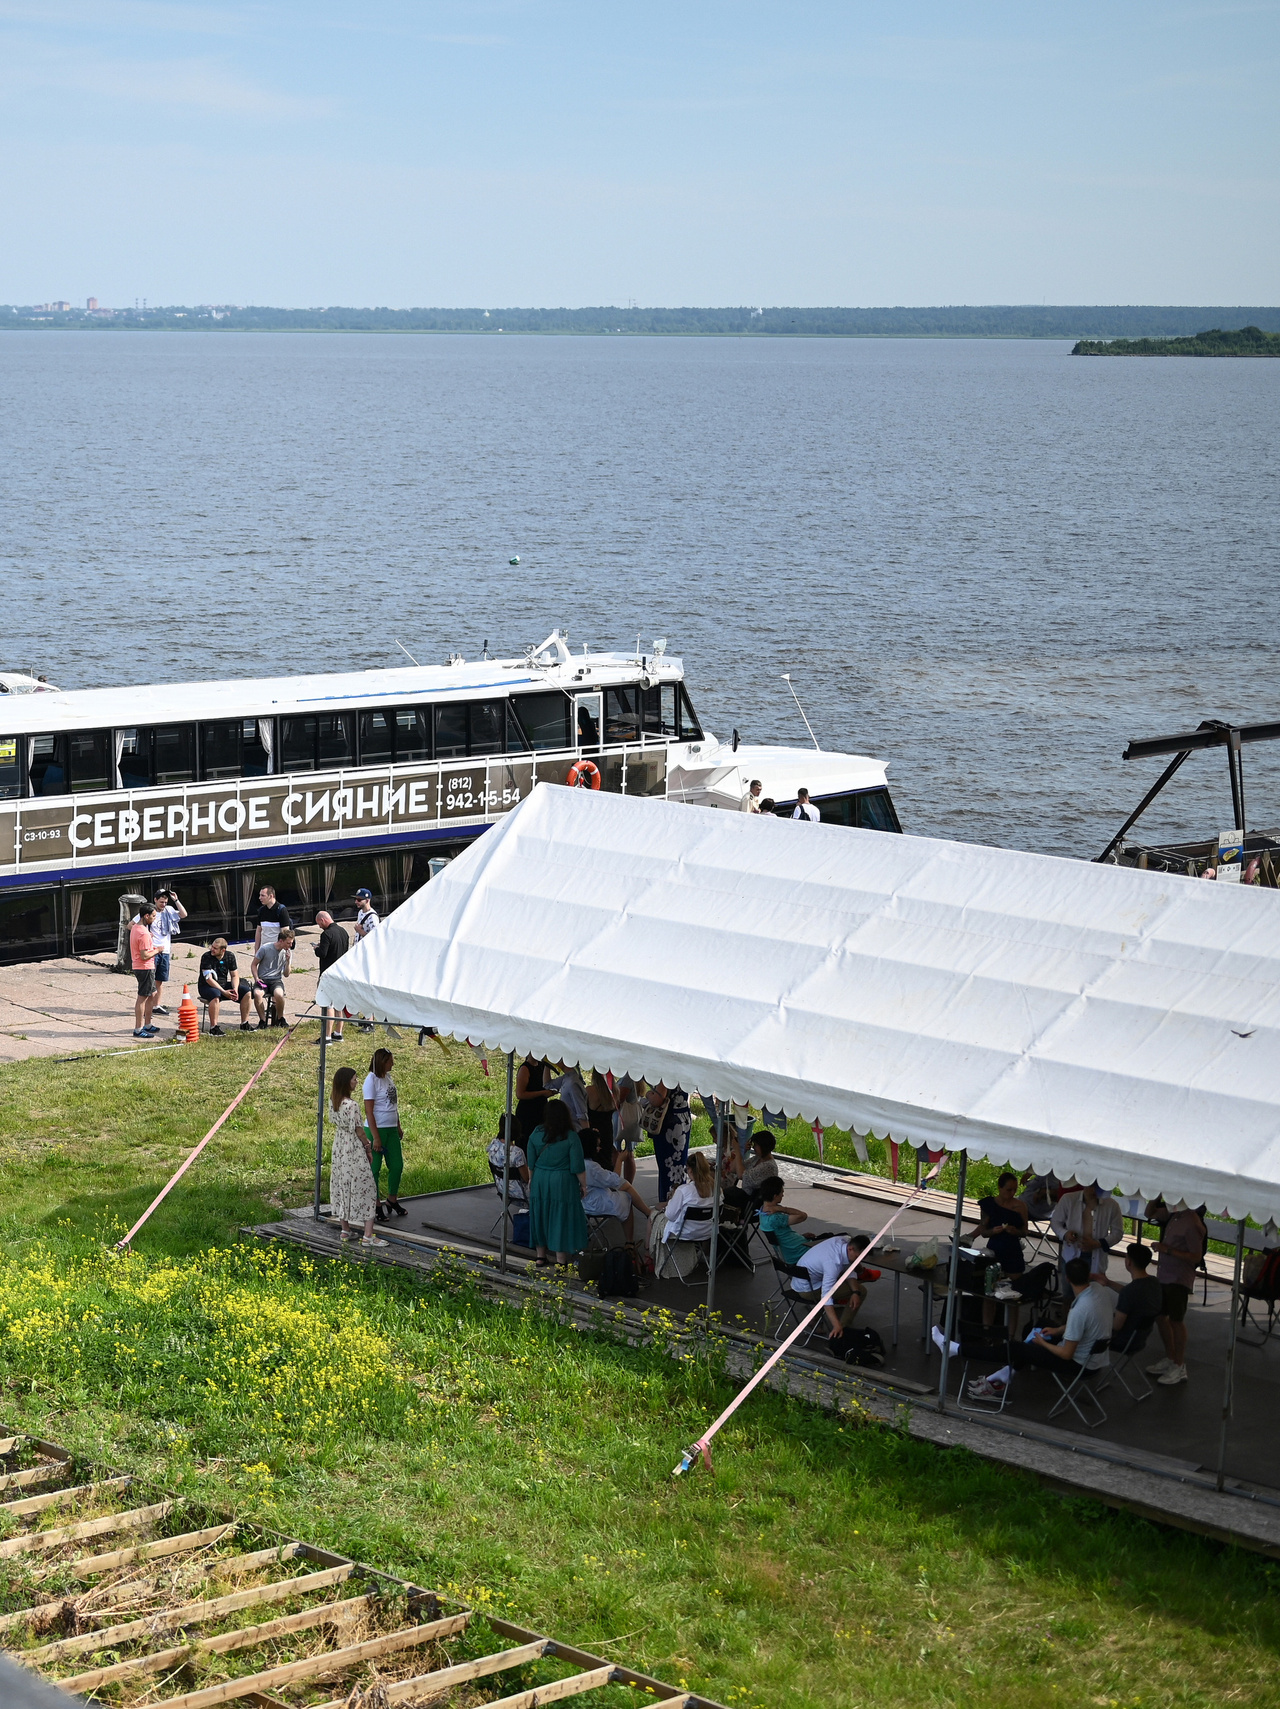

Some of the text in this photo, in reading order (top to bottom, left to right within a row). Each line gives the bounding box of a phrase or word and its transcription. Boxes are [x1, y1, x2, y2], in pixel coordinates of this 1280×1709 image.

[448, 776, 472, 792] (812)
[68, 781, 429, 849] СЕВЕРНОЕ СИЯНИЕ
